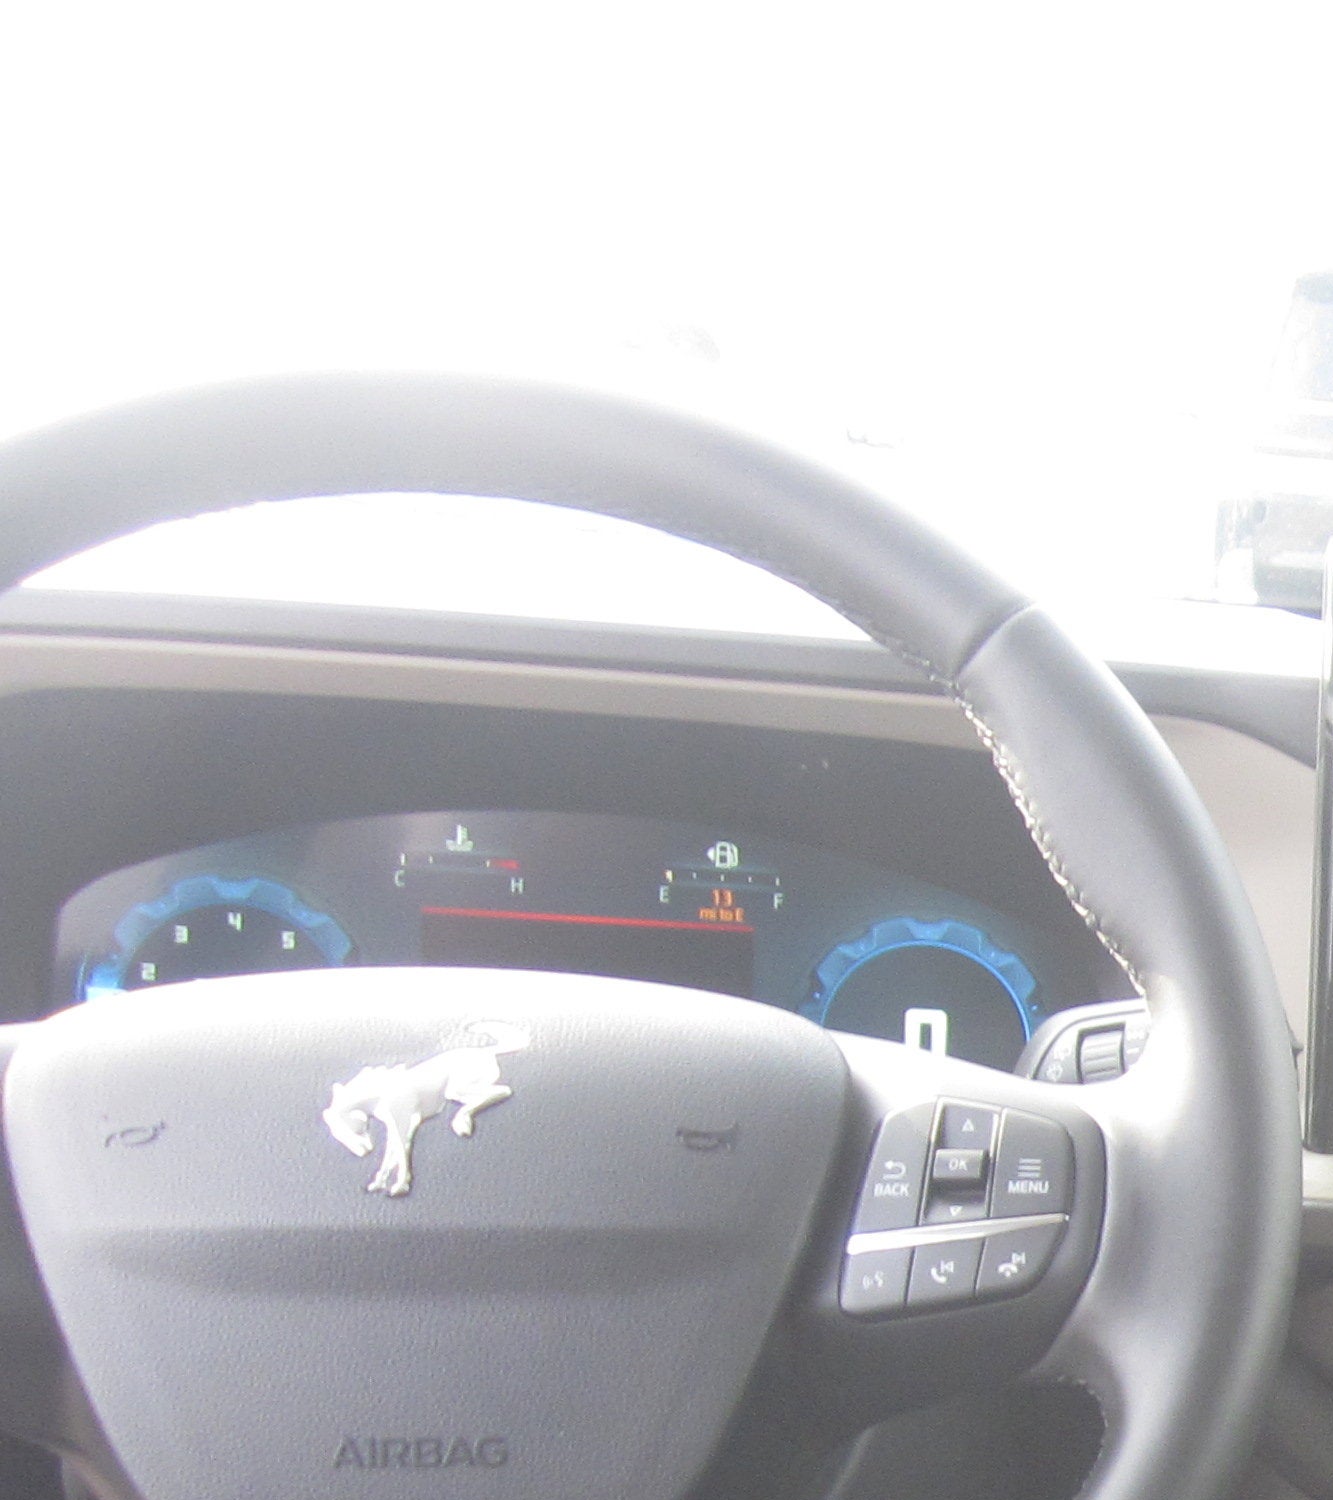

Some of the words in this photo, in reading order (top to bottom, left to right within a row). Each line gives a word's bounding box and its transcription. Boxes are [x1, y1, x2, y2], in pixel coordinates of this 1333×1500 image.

[226, 911, 243, 932] 4
[174, 925, 190, 945] 3
[281, 931, 296, 950] 5
[948, 1158, 967, 1172] OK
[874, 1182, 909, 1197] BACK
[1007, 1180, 1048, 1194] MENU
[333, 1435, 508, 1469] AIRBAG
